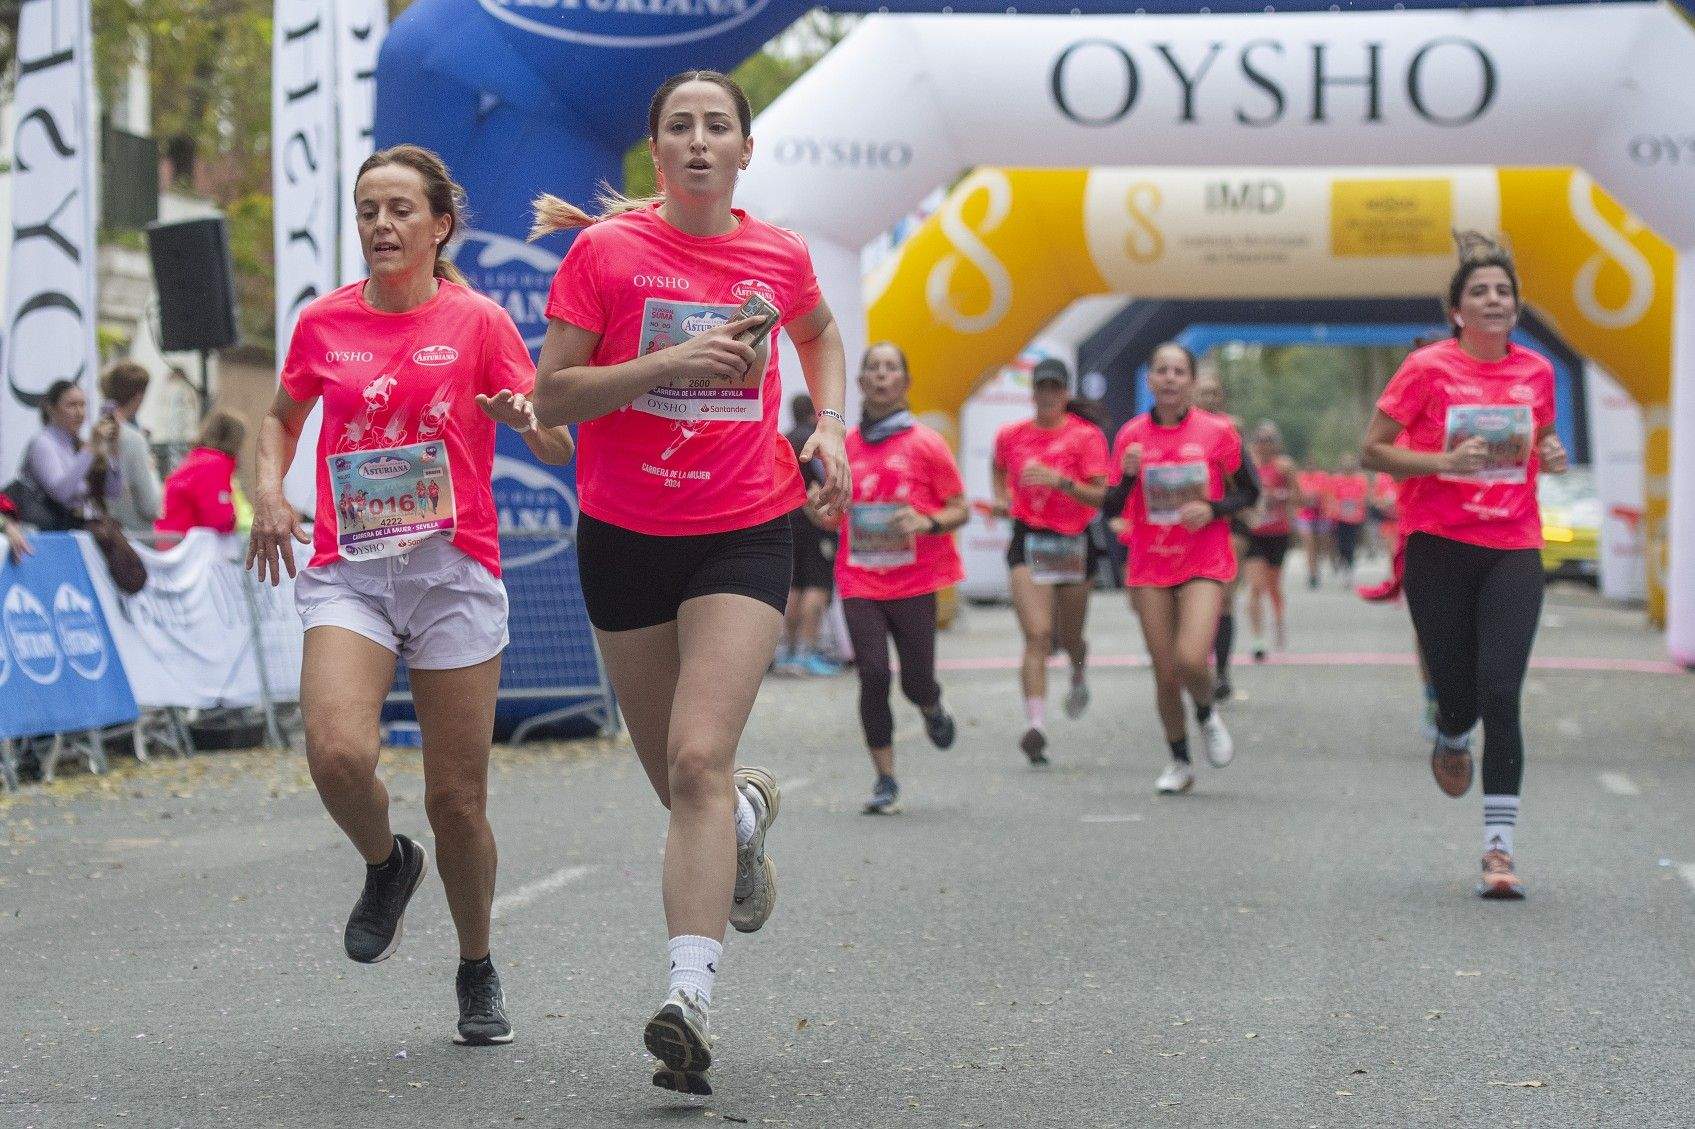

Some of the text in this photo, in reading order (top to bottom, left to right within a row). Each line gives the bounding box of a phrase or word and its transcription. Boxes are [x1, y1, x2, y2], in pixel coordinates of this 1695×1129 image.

[1050, 36, 1498, 127] OYSHO
[633, 274, 690, 290] OYSHO
[325, 350, 374, 363] OYSHO
[688, 380, 711, 388] 2600
[653, 388, 680, 397] CARRERA
[647, 398, 687, 413] OYSHO
[710, 405, 747, 413] Santander
[363, 464, 409, 476] ASTURIANA
[641, 462, 711, 480] CARRERA DE LA MUJER
[663, 478, 681, 488] 2024
[369, 494, 415, 515] 016
[381, 517, 403, 527] 4222
[352, 532, 374, 540] CARRERA
[392, 525, 411, 533] MUJER
[415, 522, 438, 531] SEVILLA
